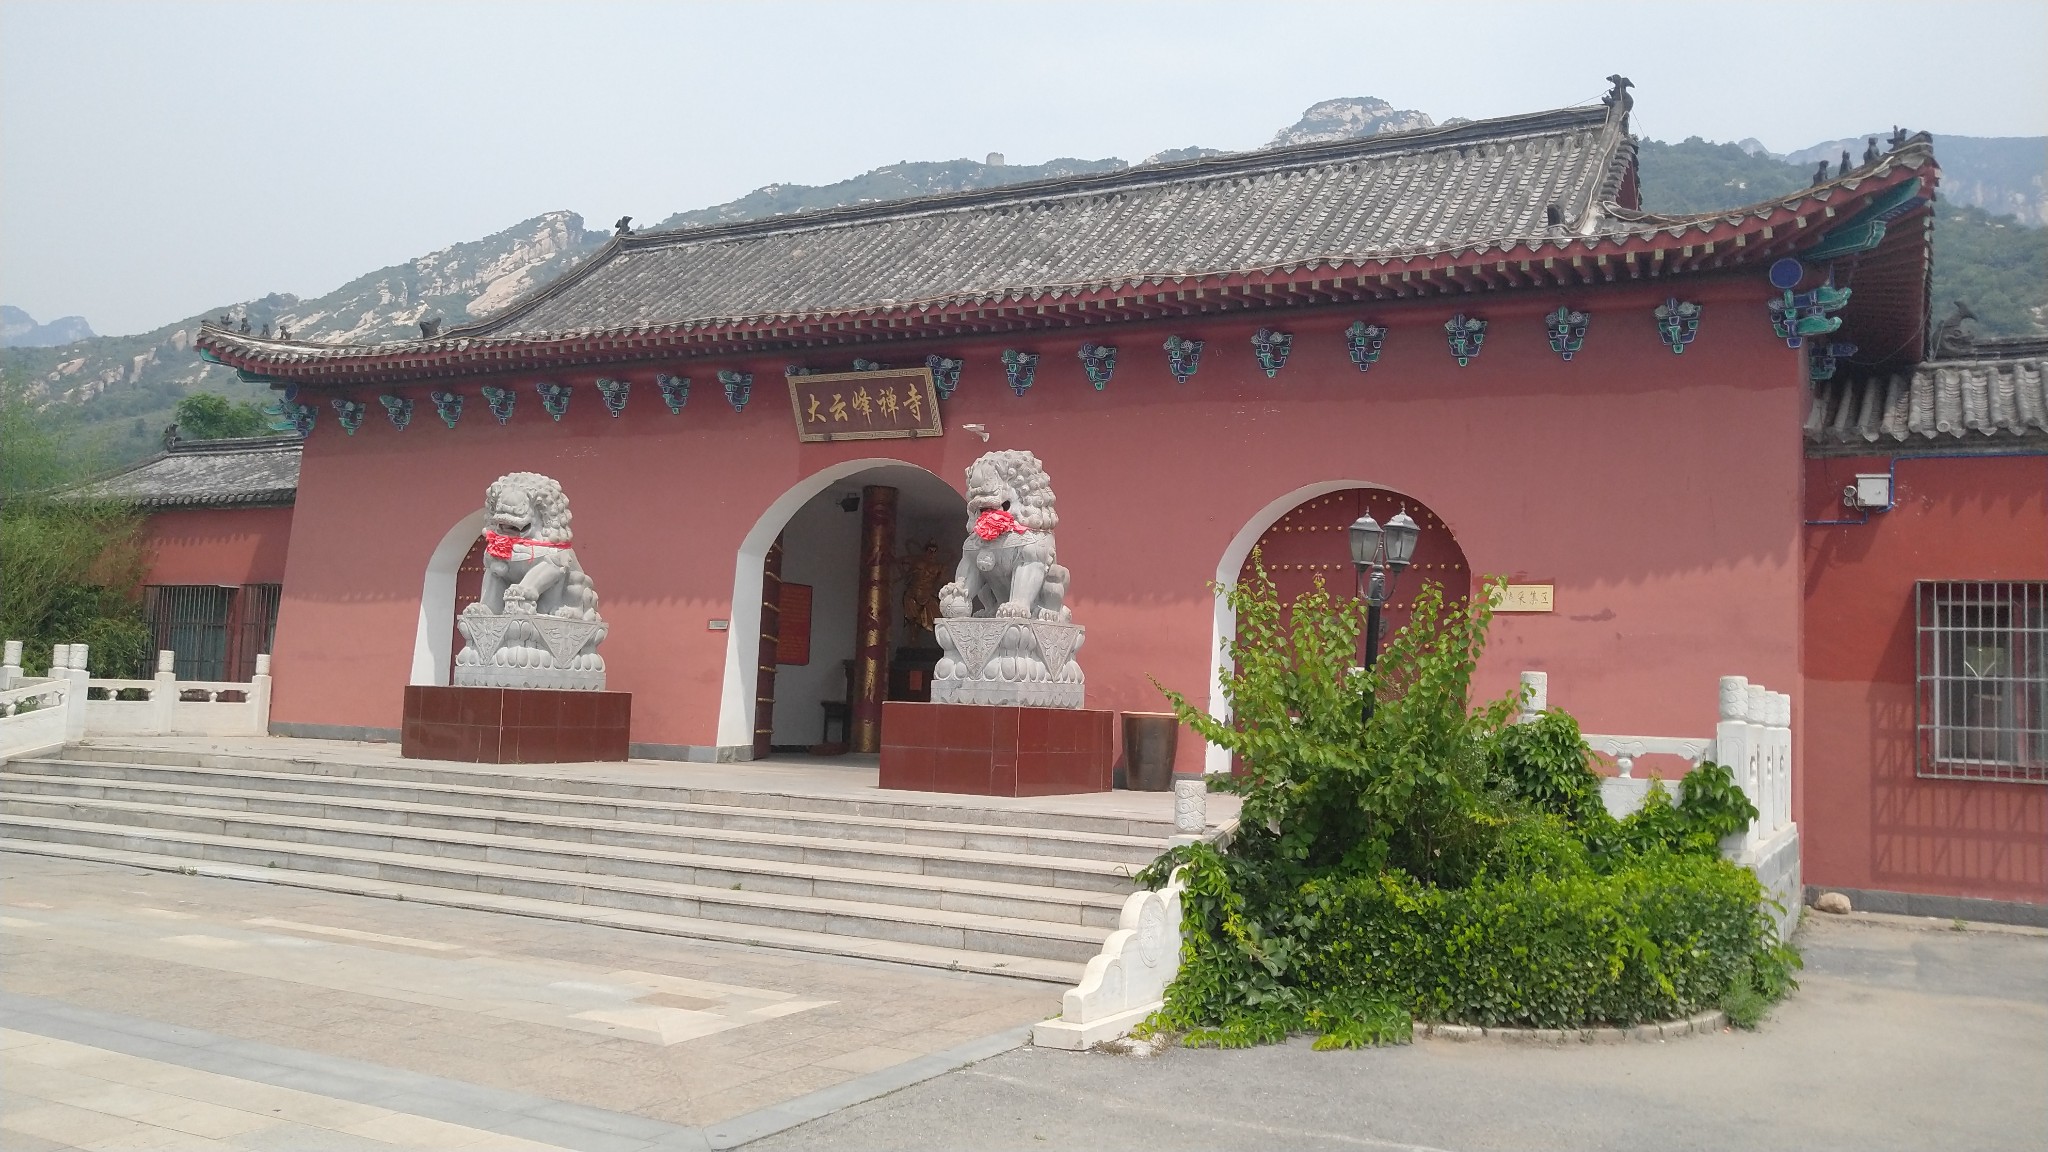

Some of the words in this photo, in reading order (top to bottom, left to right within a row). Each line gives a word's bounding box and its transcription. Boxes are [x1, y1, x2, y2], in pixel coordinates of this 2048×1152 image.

[808, 383, 923, 425] 大云峰禅寺
